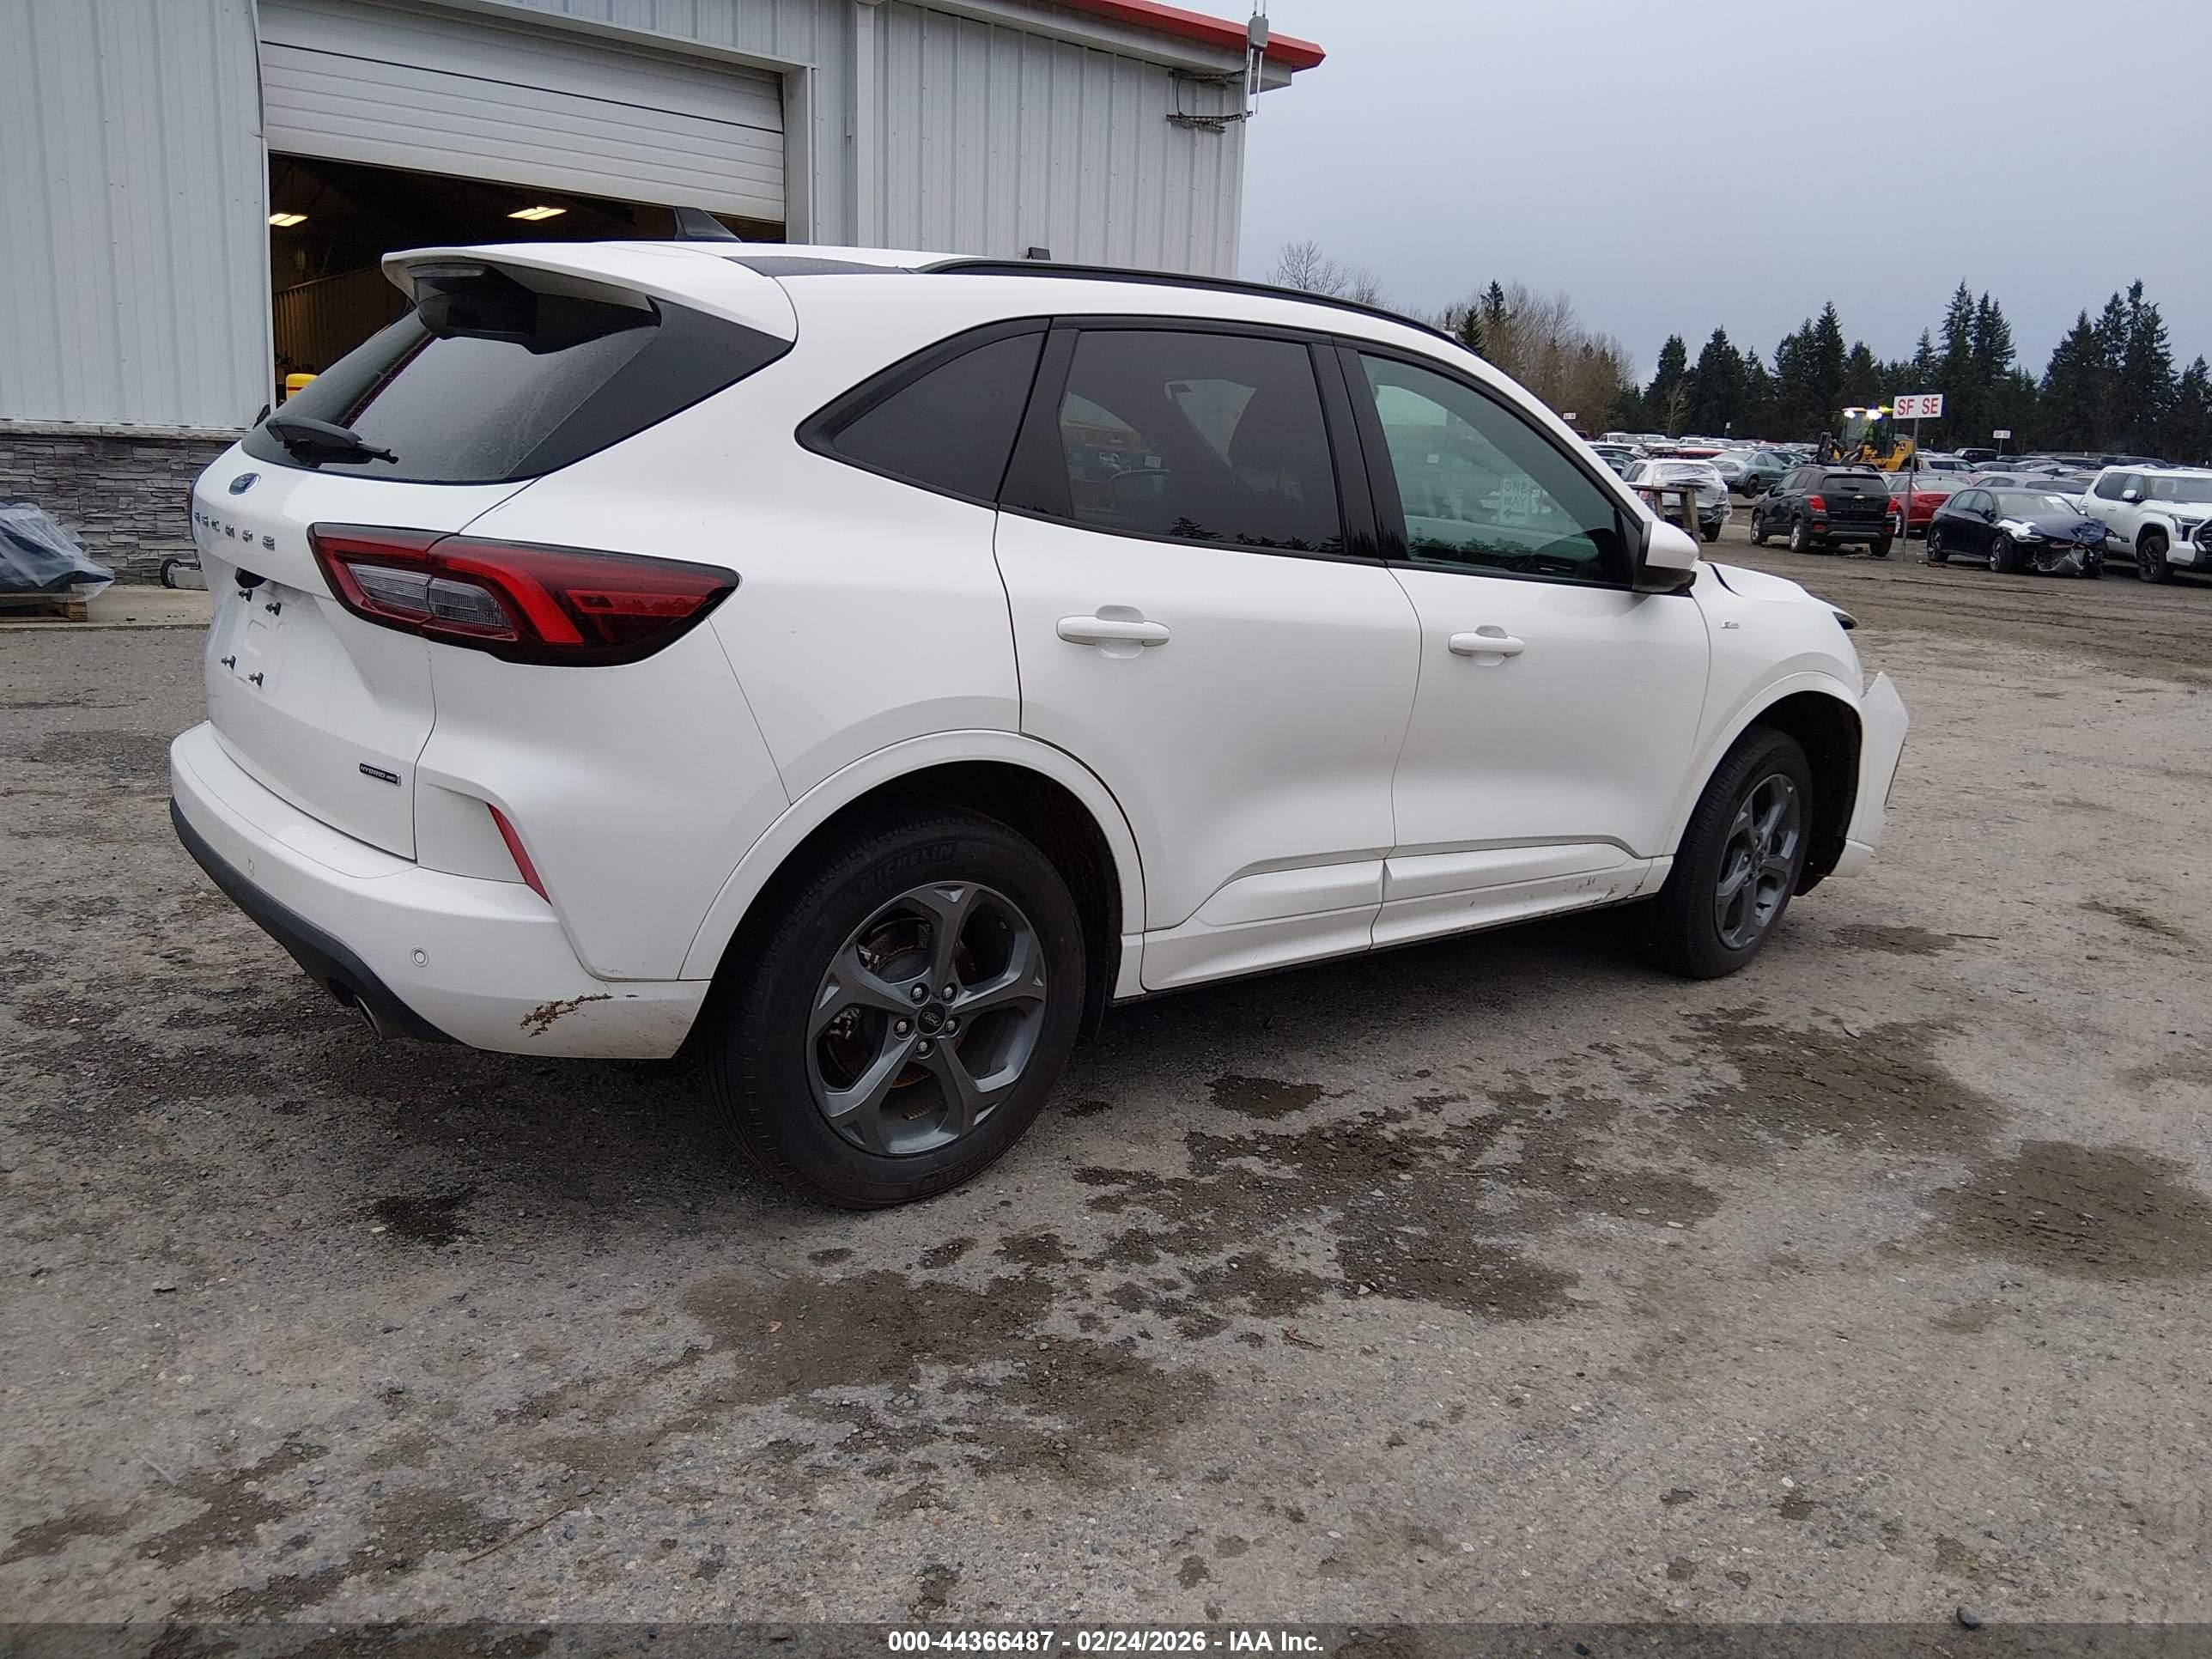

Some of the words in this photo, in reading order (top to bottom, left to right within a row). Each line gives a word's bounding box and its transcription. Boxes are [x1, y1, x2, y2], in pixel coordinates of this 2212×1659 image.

[1897, 398, 1915, 416] SF
[1922, 398, 1939, 415] SE
[1504, 482, 1528, 494] ONE
[1504, 495, 1526, 507] WAY
[858, 844, 955, 894] MICHELIN
